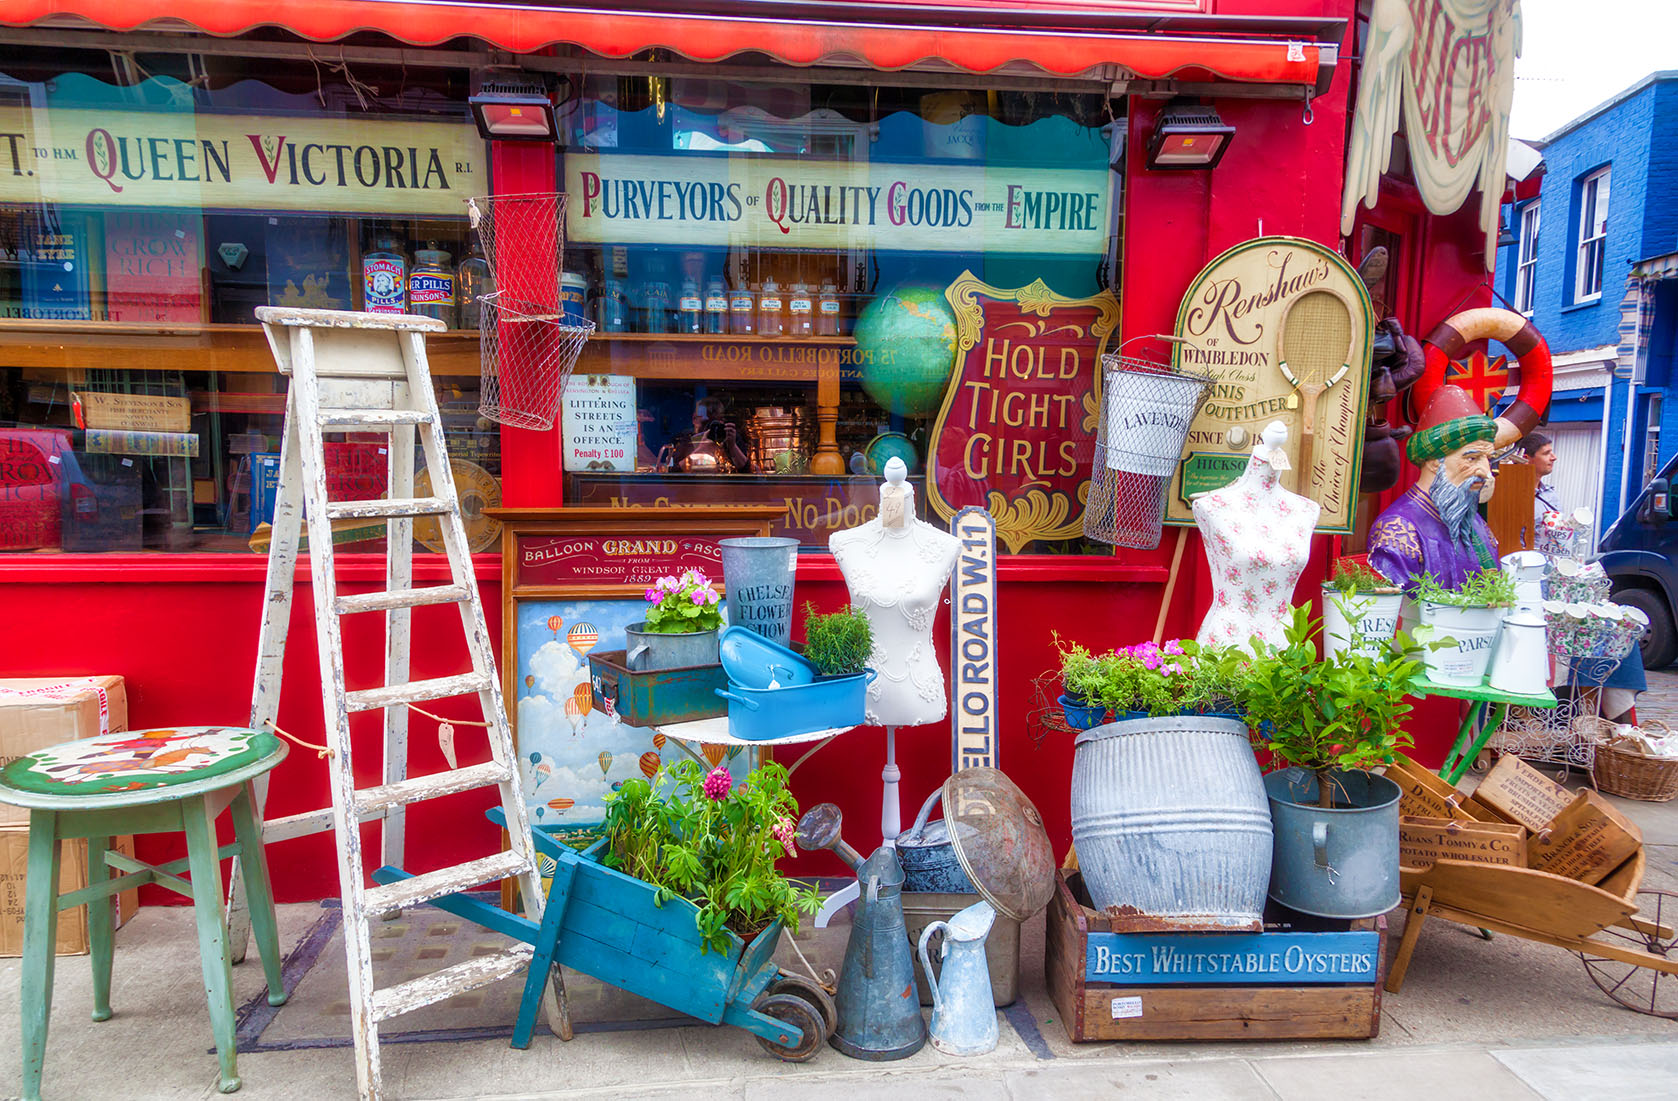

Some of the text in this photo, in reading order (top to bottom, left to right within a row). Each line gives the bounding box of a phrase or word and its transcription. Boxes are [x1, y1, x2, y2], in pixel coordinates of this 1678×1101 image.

[34, 147, 48, 158] TO
[53, 148, 78, 160] H.M.
[85, 127, 231, 193] QUEEN
[246, 134, 450, 189] VICTORIA
[580, 171, 1099, 235] PURVEYORS OF QUALITY GOODS FROM THE EMPIRE
[37, 235, 74, 245] JANE
[112, 238, 188, 257] GROW
[37, 249, 75, 259] EYRE
[119, 258, 185, 277] RICH
[366, 263, 401, 275] STOMACH
[422, 279, 451, 291] PILLS
[1187, 249, 1330, 346] Renshaw's
[1206, 338, 1219, 347] OF
[983, 337, 1080, 380] HOLD
[1183, 349, 1270, 366] WIMBLEDON
[570, 399, 627, 409] LITTERING
[964, 380, 1076, 430] TIGHT
[1328, 377, 1354, 446] Champions
[574, 412, 623, 421] STREETS
[583, 424, 595, 433] IS
[598, 424, 613, 433] AN
[573, 436, 625, 445] OFFENCE.
[1188, 431, 1265, 446] SINCE 18
[574, 448, 602, 460] Penalty
[963, 432, 1078, 481] GIRLS
[1196, 458, 1248, 472] HICKSO
[1311, 459, 1327, 489] The
[826, 497, 880, 528] DOG
[1546, 529, 1568, 539] CUPS
[525, 539, 722, 562] BALLOON GRAND ASC
[627, 557, 651, 565] FROM
[572, 566, 626, 575] WINDSOR
[632, 566, 670, 575] GREAT
[623, 575, 652, 584] 1889
[738, 585, 790, 602] CHELSE
[1358, 616, 1396, 634] FRES
[962, 592, 989, 684] ROAD
[1514, 760, 1546, 787] VERDE
[1411, 784, 1442, 813] DAVID
[1510, 798, 1547, 825] SPITALFIE
[1094, 944, 1371, 974] BEST WHITSTABLE OYSTERS
